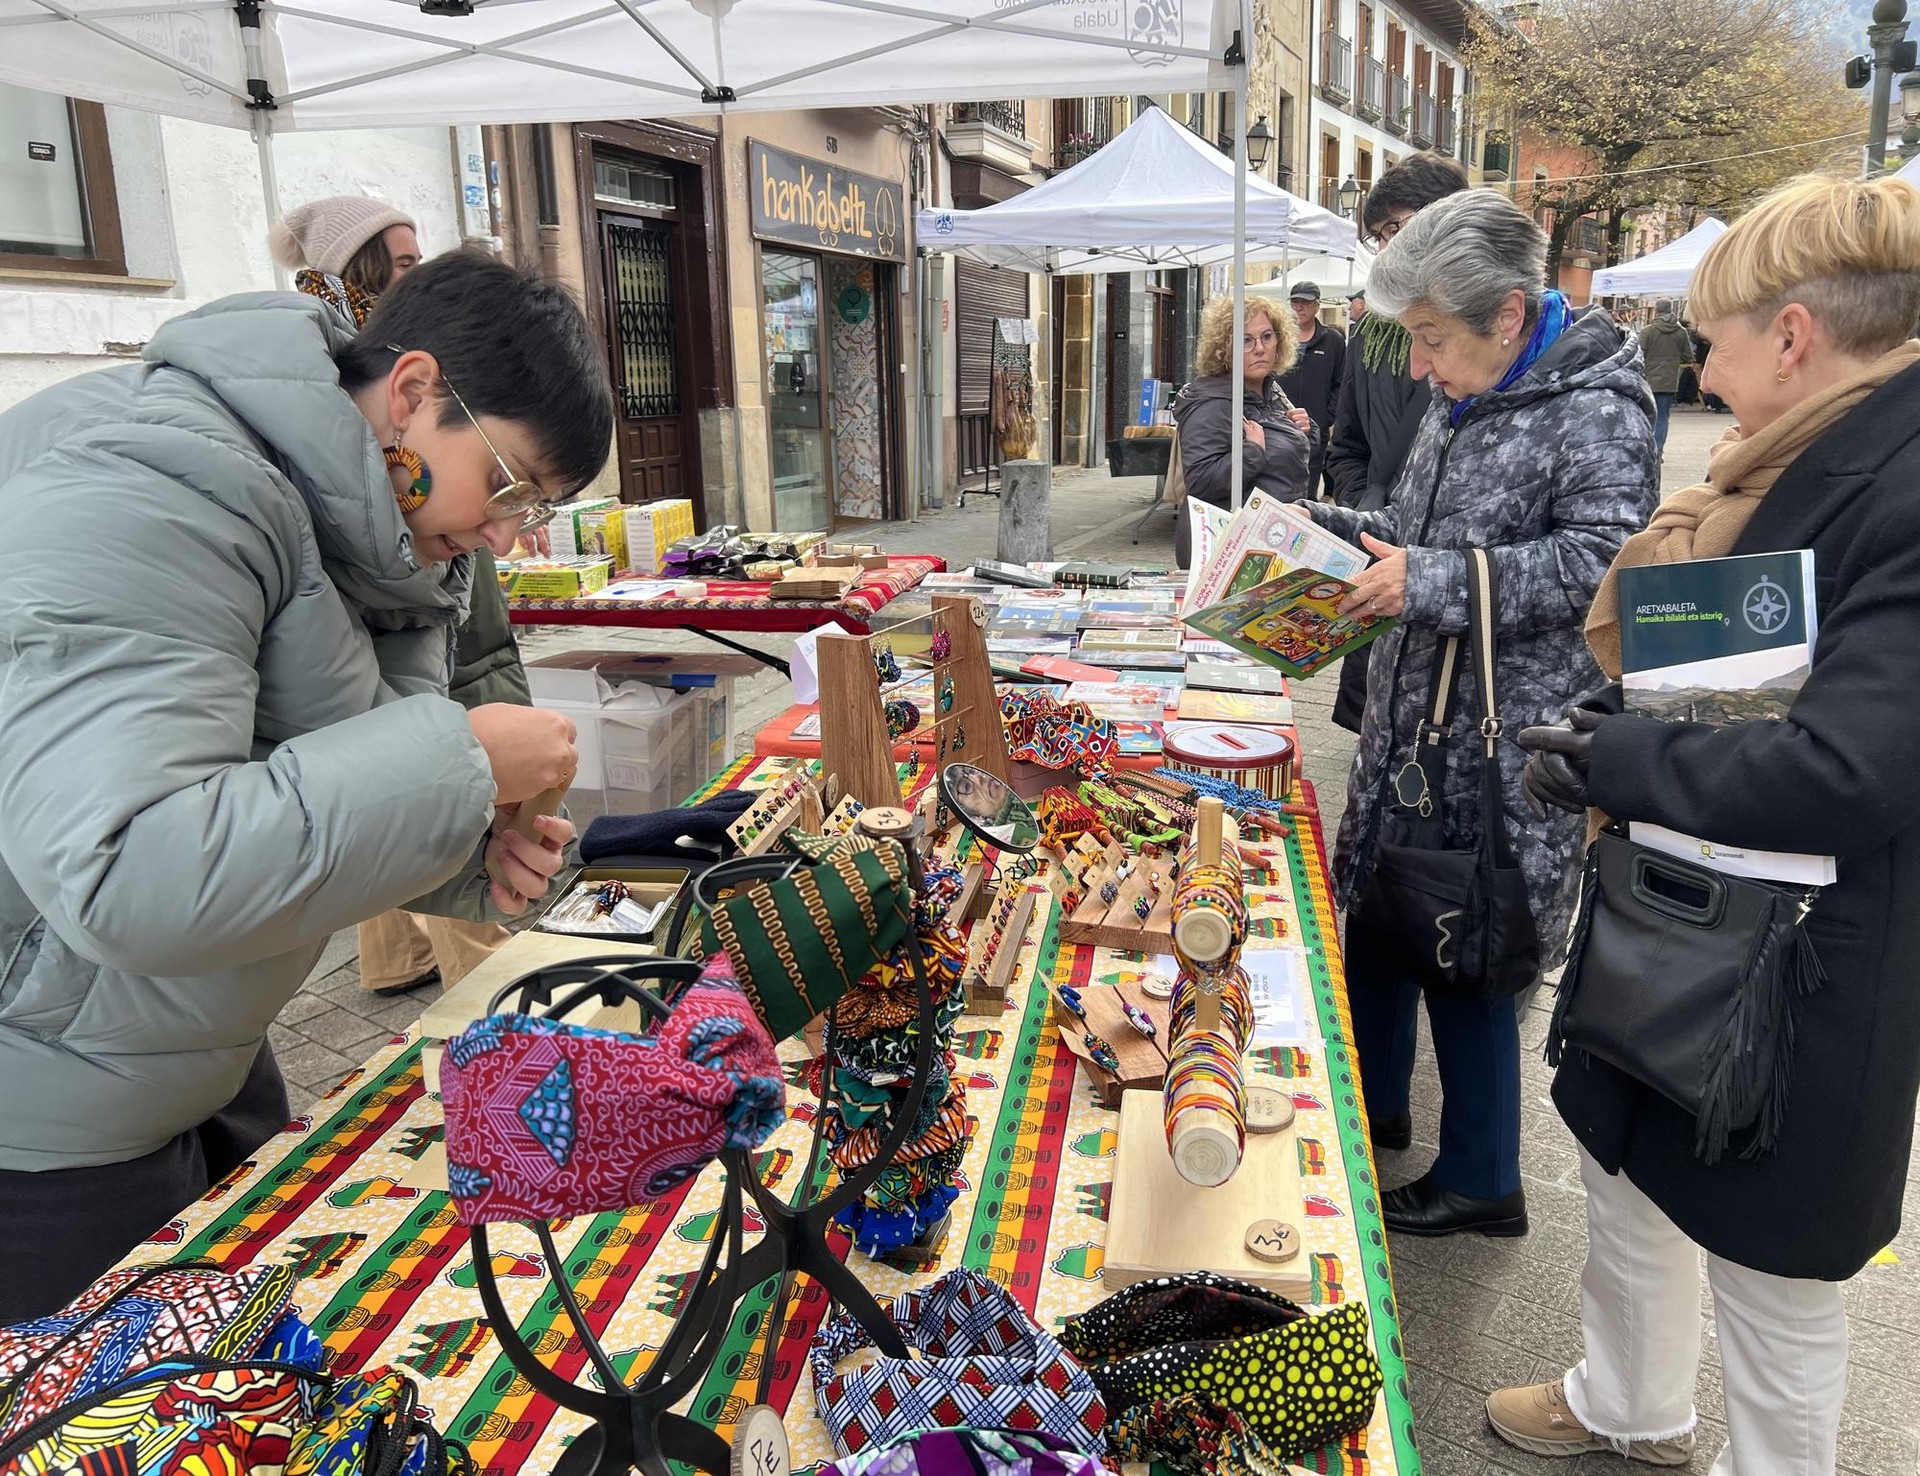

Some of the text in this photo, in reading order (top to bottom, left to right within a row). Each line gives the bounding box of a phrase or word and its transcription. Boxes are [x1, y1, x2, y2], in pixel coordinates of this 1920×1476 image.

[1208, 572, 1216, 582] DE
[1198, 589, 1213, 609] Buddy
[1636, 602, 1697, 615] ARETXABALETA
[1635, 614, 1664, 624] Hamaika
[1688, 614, 1699, 622] eta
